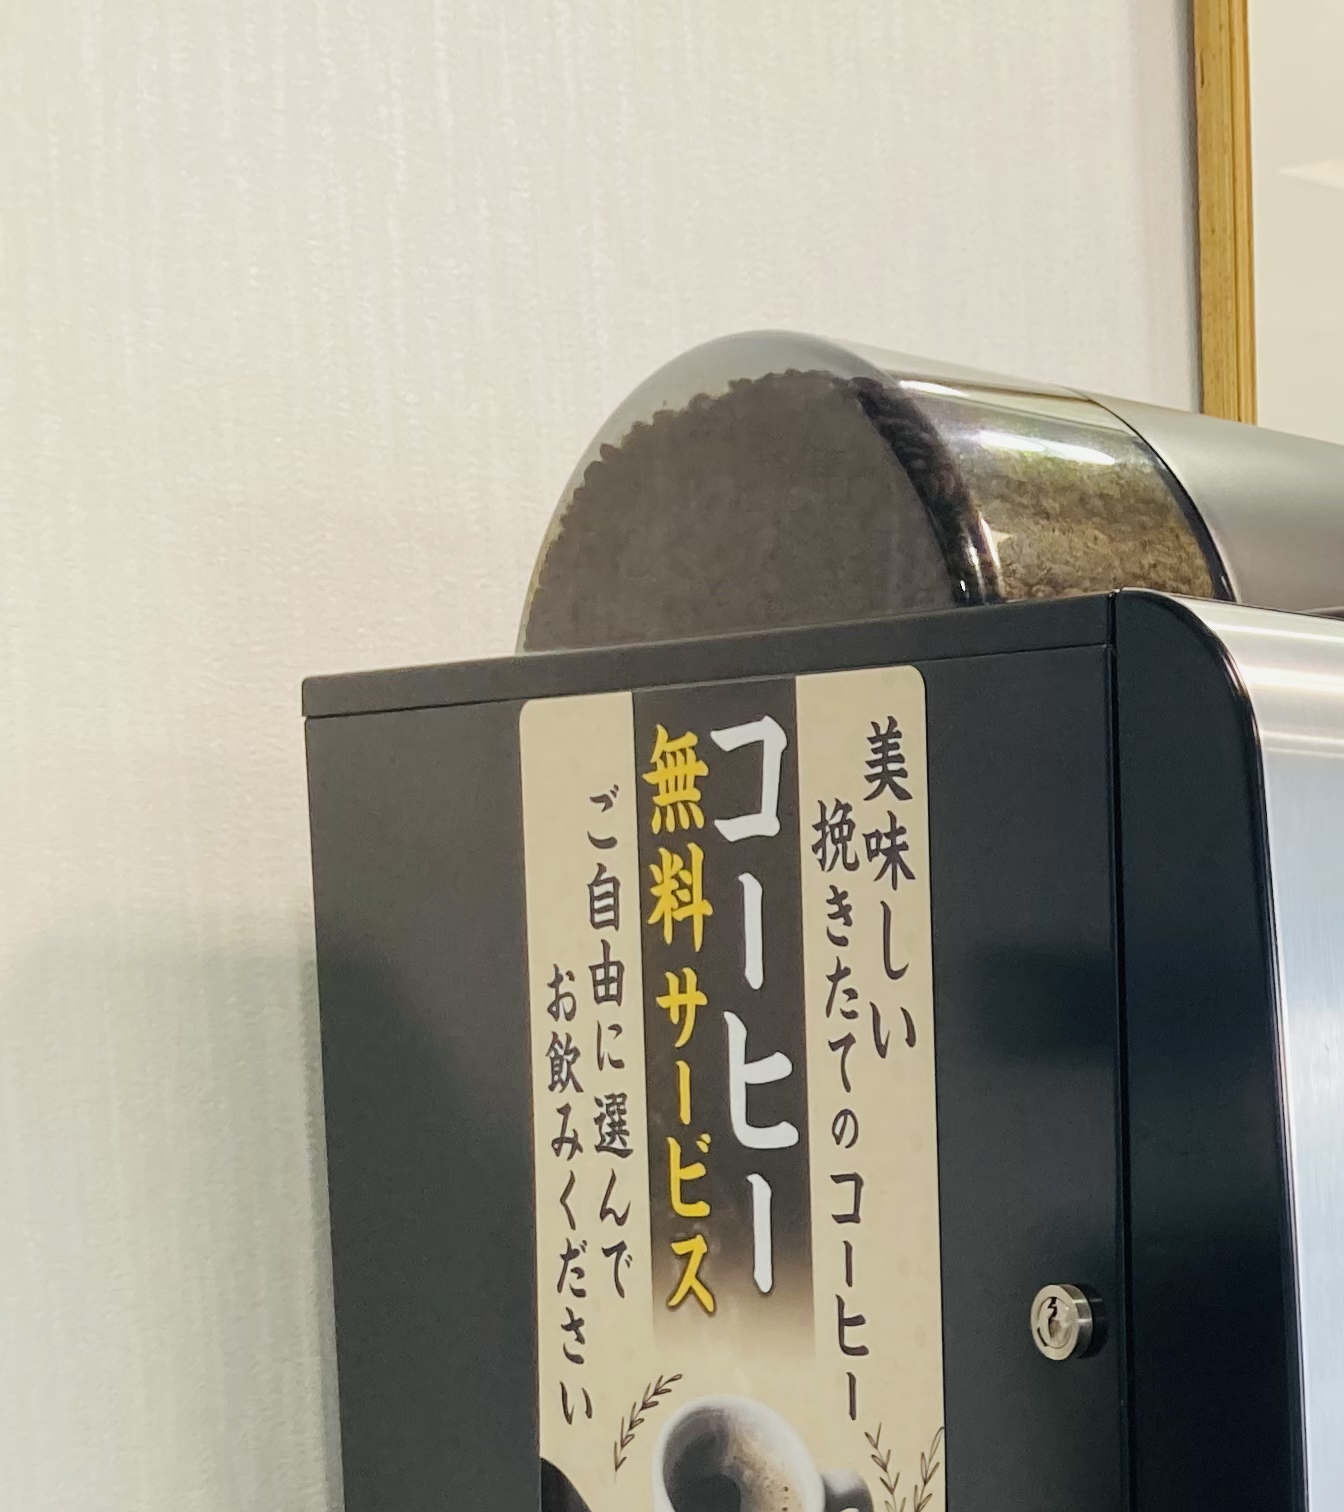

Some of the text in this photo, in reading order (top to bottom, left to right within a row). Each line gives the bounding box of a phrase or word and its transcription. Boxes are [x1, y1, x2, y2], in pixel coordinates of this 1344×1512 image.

[585, 784, 634, 1300] ご自由に選んで
[641, 724, 716, 1314] 無料サービス
[709, 714, 799, 1294] コーヒー
[811, 798, 871, 1421] 挽きたてのコーヒー
[863, 716, 916, 1058] 美味しい
[545, 965, 594, 1424] お飲みください
